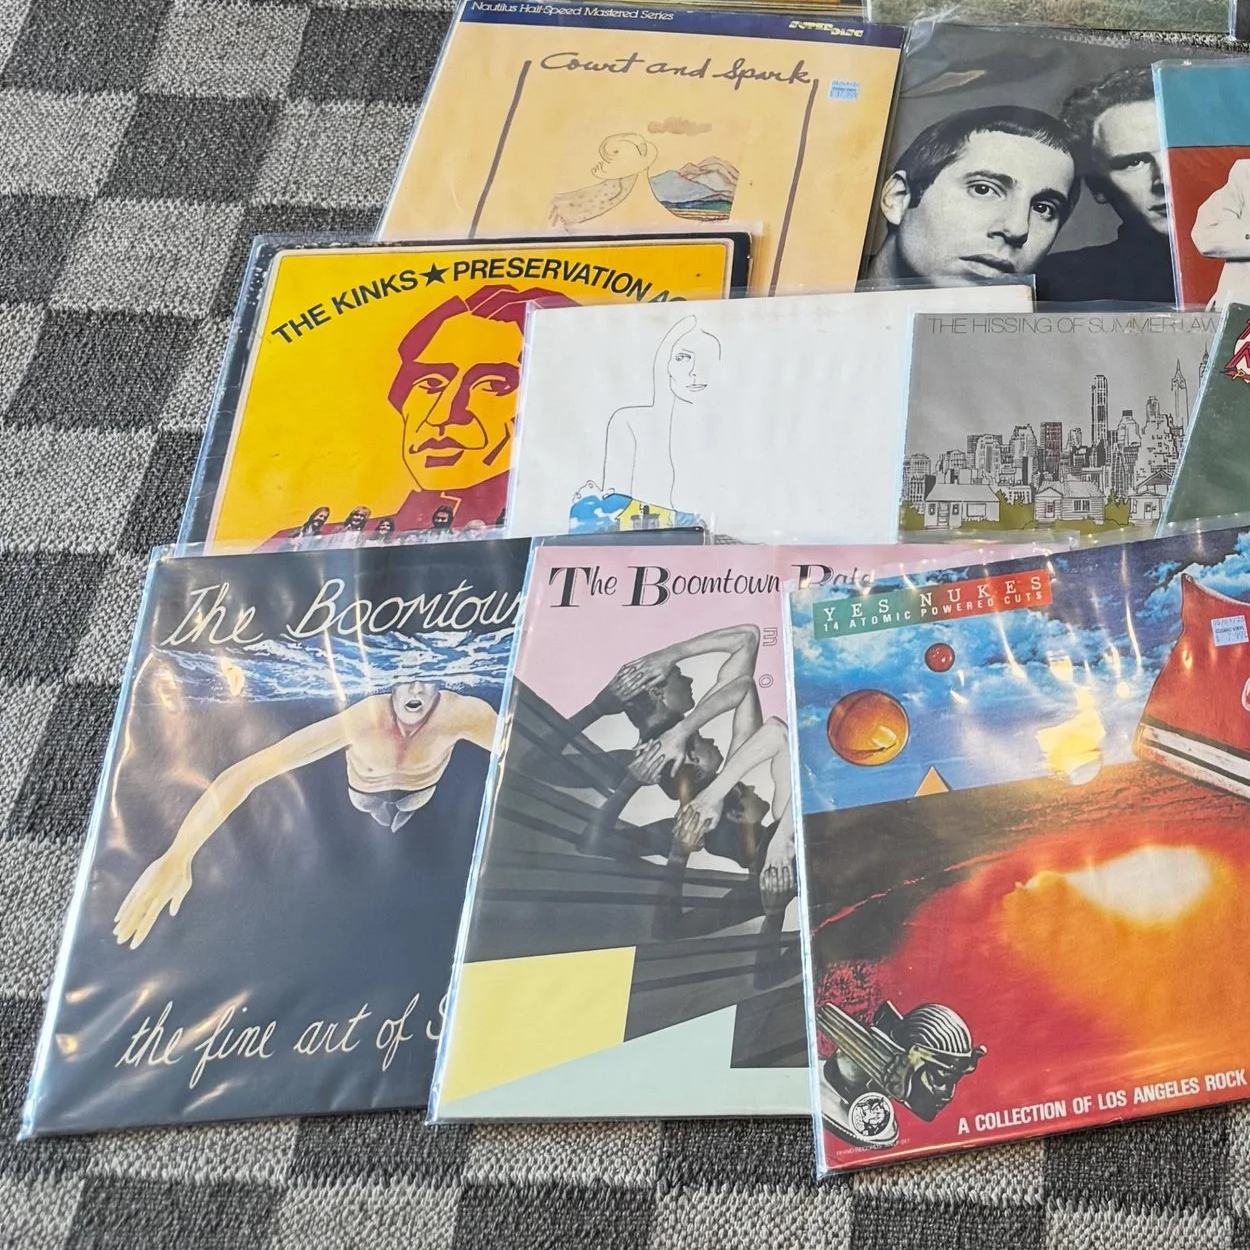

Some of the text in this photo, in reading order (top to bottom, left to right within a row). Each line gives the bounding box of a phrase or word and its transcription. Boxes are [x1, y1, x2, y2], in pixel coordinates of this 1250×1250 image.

[471, 0, 674, 22] Nautilus Half-Speed Mastered Series
[540, 50, 639, 75] Court
[646, 57, 711, 80] and
[713, 59, 812, 91] Spark
[270, 257, 654, 345] THE KINKS PRESERVATION
[928, 317, 968, 335] THE
[972, 317, 1052, 335] HISSING
[1057, 317, 1085, 335] OF
[1088, 317, 1174, 335] SUMMER
[548, 564, 617, 608] The
[623, 564, 781, 609] Boomtown
[822, 575, 1044, 623] YES NUKES
[160, 583, 265, 647] The
[823, 590, 1044, 633] 14 ATOMIC POWERED CUTS
[116, 1001, 183, 1068] the
[190, 1007, 274, 1088] fine
[293, 1004, 361, 1053] art
[375, 994, 419, 1071] of
[958, 1118, 970, 1135] A
[974, 1100, 1067, 1131] COLLECTION
[1073, 1096, 1093, 1113] OF
[1097, 1090, 1127, 1110] LOS
[1131, 1077, 1201, 1105] ANGELES
[1204, 1070, 1247, 1092] ROCK
